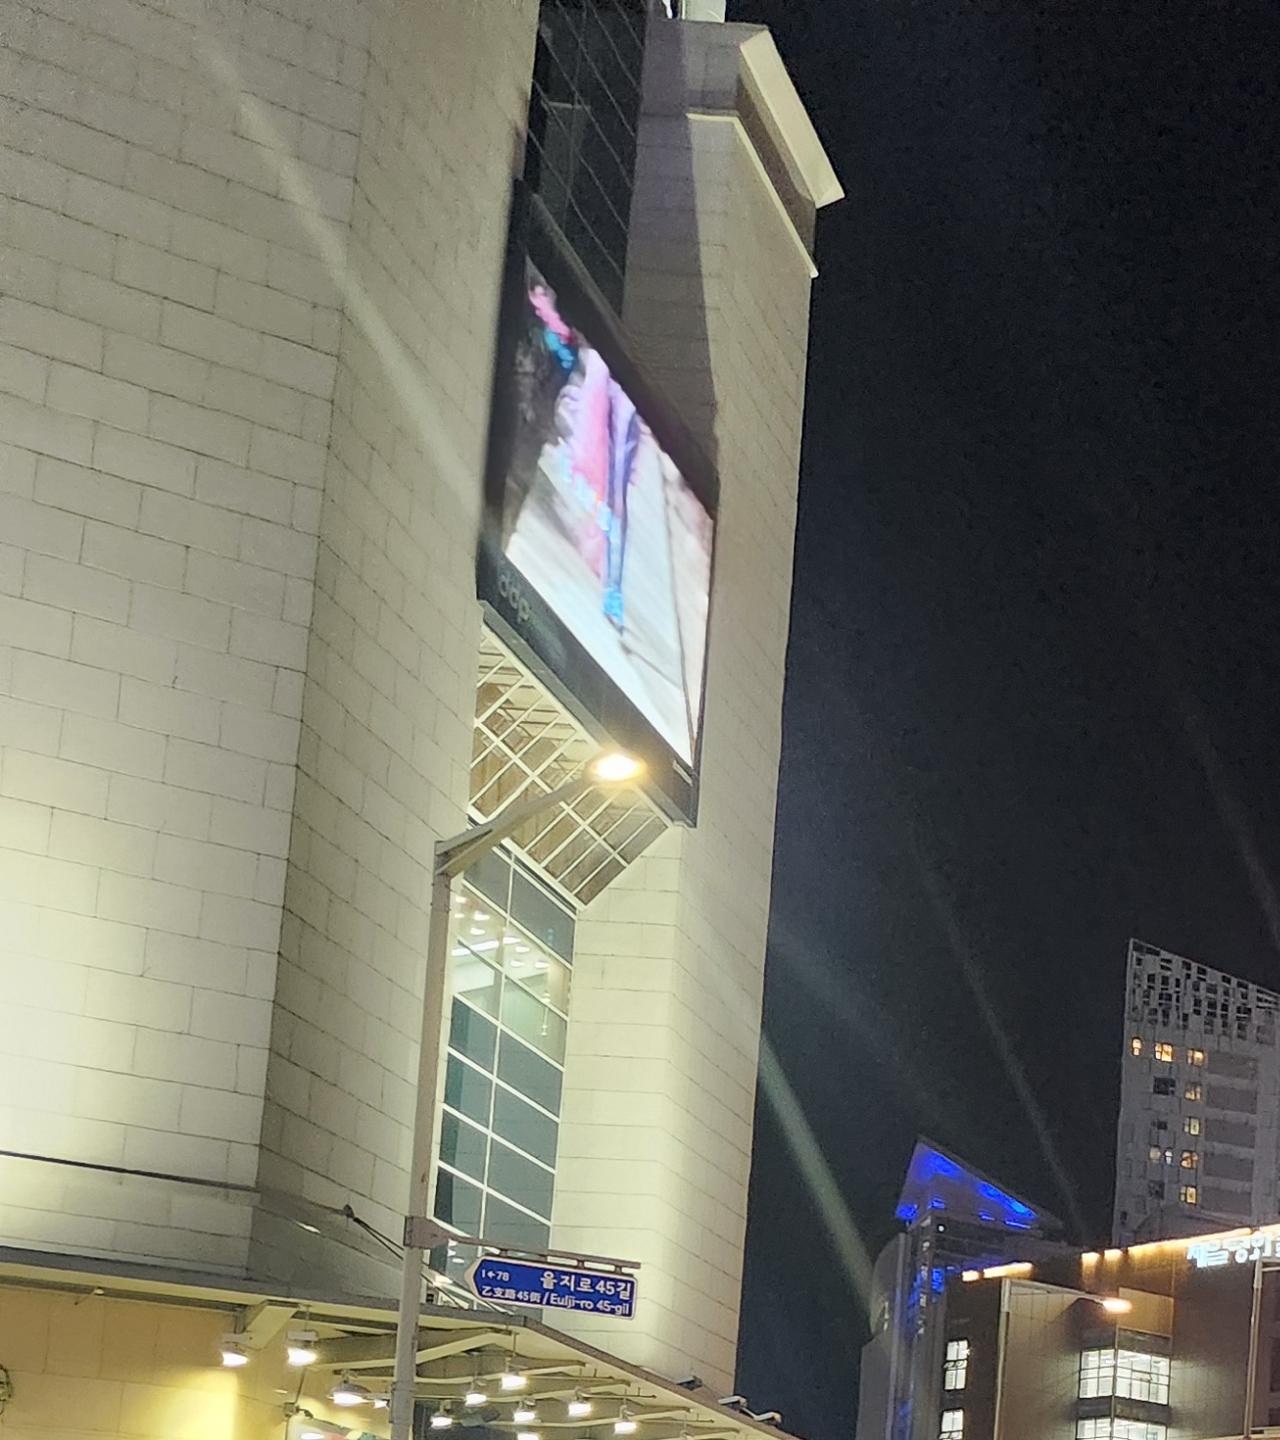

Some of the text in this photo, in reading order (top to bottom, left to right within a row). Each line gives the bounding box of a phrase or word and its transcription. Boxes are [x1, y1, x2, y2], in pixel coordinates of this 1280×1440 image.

[496, 1270, 510, 1281] 78
[540, 1271, 632, 1300] 을지로45길
[550, 1293, 594, 1310] Eulji-ro
[595, 1298, 629, 1316] 45-gil
